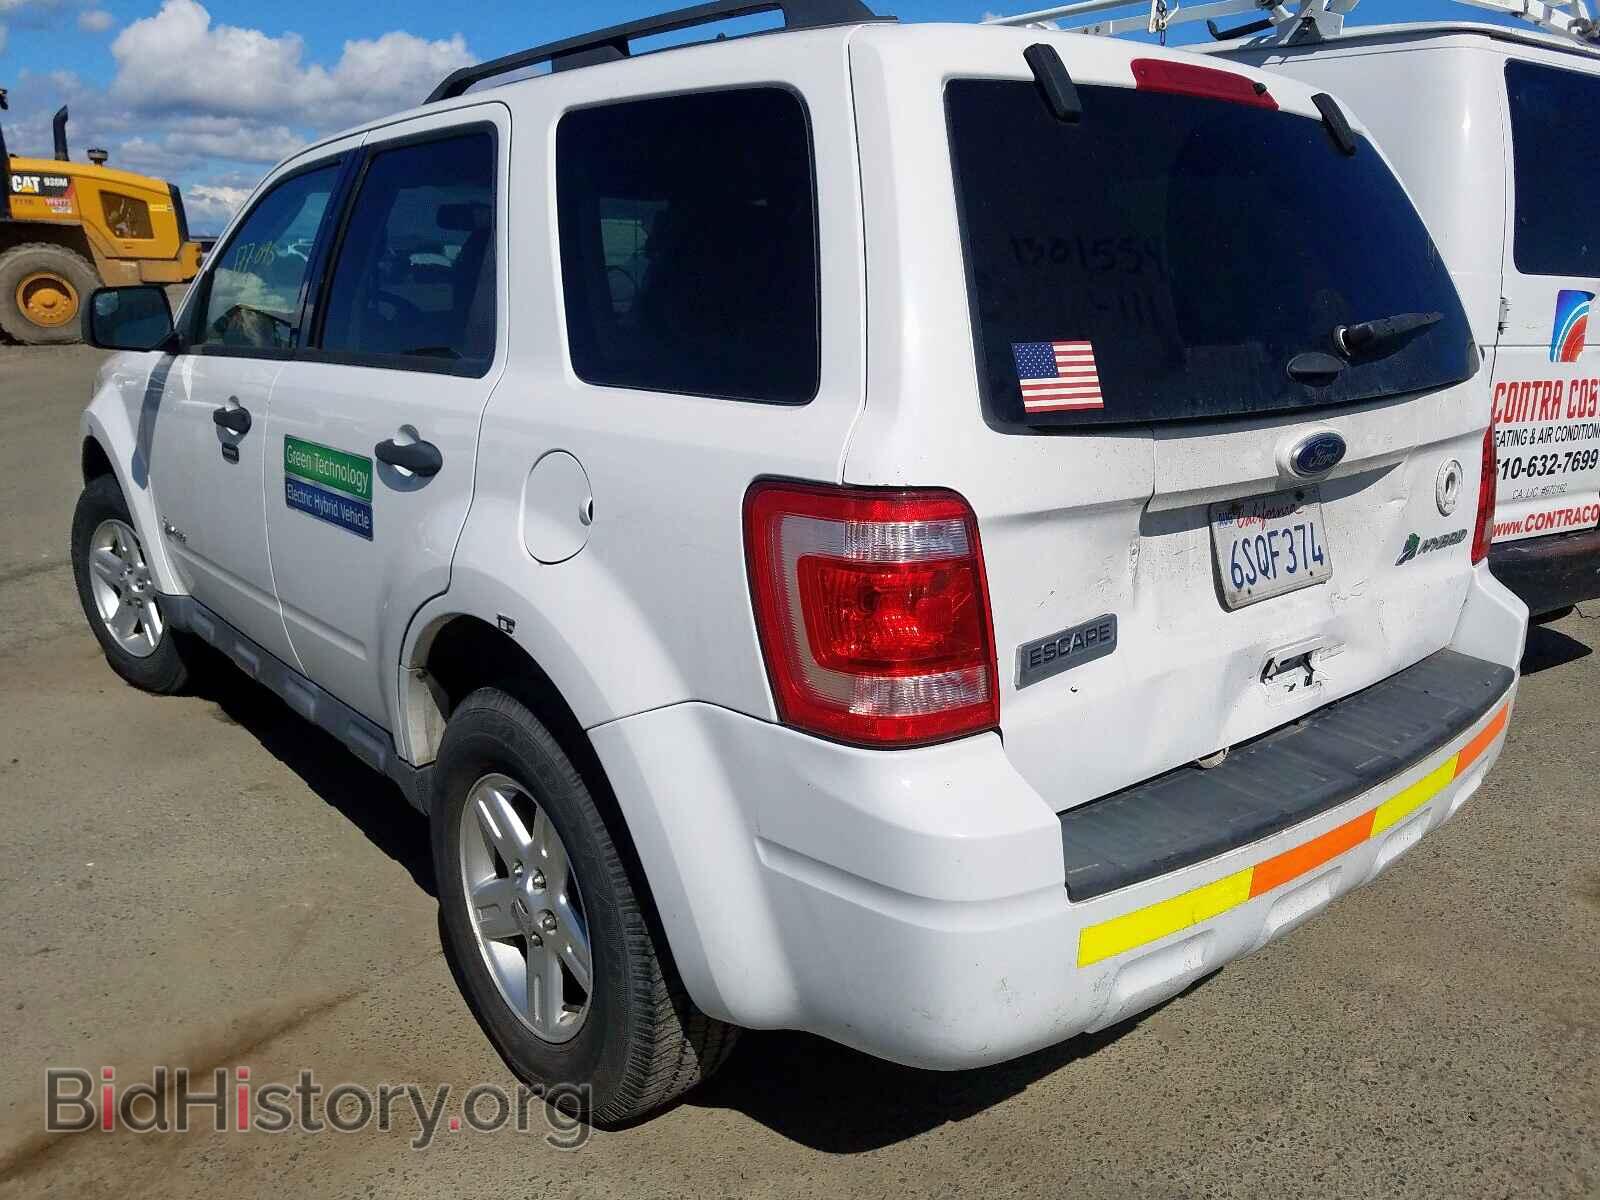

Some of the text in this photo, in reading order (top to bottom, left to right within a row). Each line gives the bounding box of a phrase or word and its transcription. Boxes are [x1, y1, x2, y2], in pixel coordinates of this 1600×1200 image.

[11, 175, 41, 193] CAT
[1492, 379, 1600, 424] CONTRA COS
[1495, 423, 1600, 448] EATING & AIR CONDITION
[286, 445, 369, 494] Green Technology
[287, 483, 370, 529] Electric Hybrid Vehicle
[1236, 503, 1304, 530] California
[1231, 522, 1324, 590] 6SQF374
[1416, 528, 1468, 555] HYBRID
[1029, 622, 1112, 668] ESCAPE
